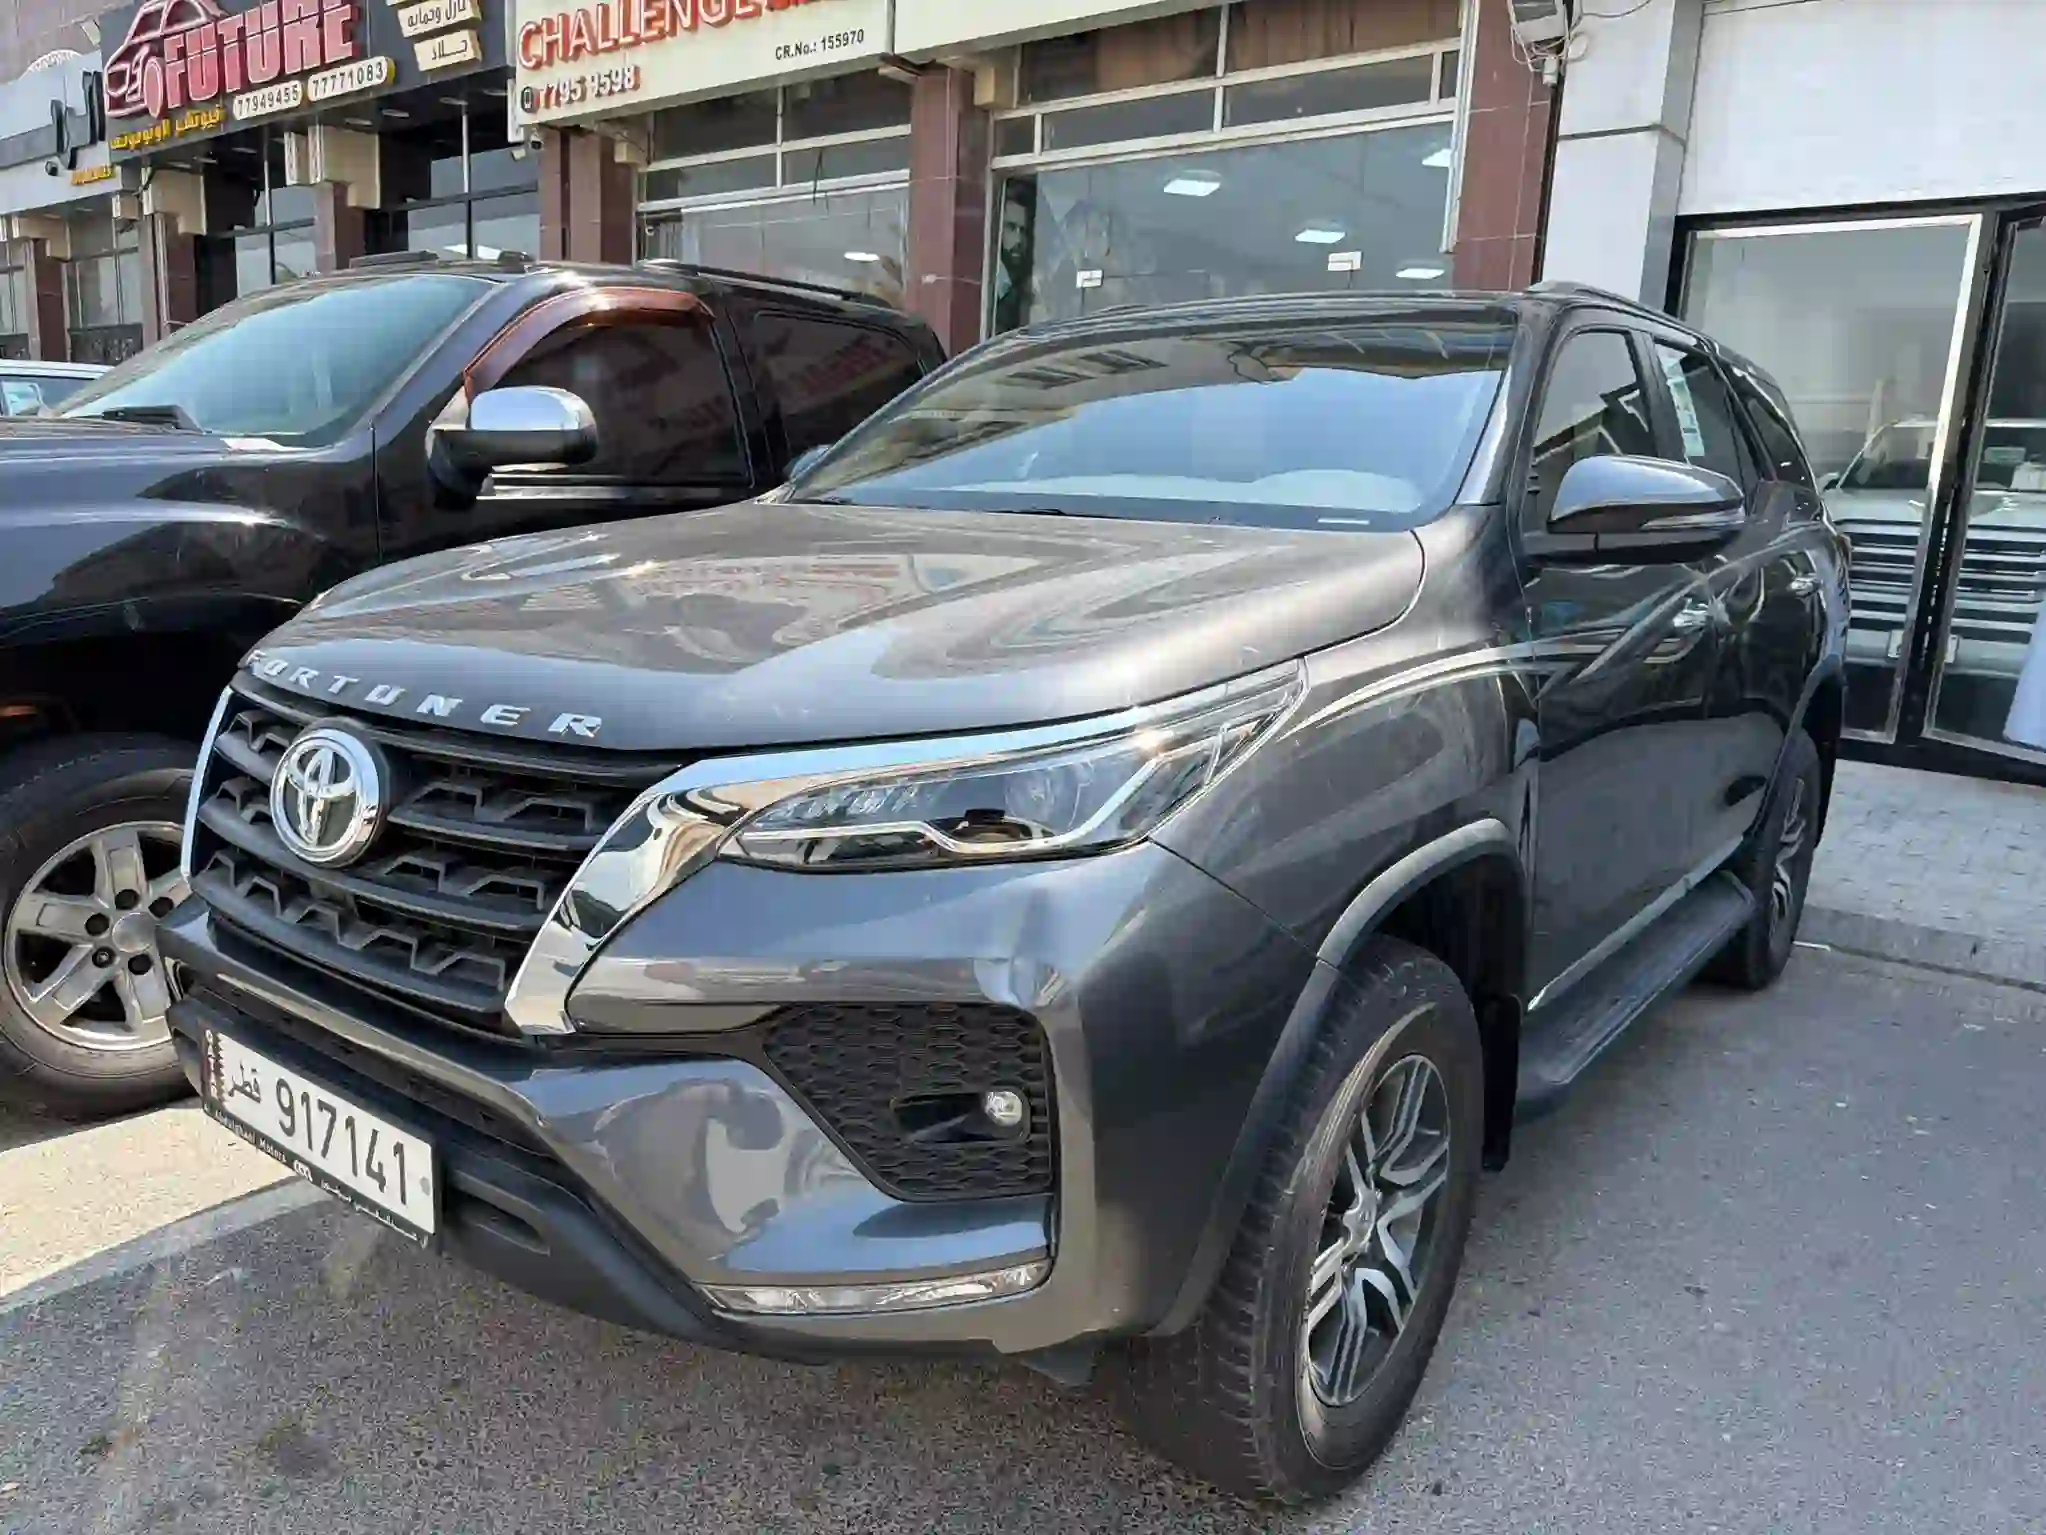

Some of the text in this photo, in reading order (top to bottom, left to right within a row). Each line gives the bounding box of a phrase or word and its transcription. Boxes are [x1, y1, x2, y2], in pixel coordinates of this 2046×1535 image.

[164, 0, 354, 109] FUTURE
[820, 28, 864, 51] 155970
[312, 62, 384, 98] 77771083
[246, 649, 603, 738] FORTUNER
[227, 1058, 262, 1104] قطر
[275, 1077, 407, 1206] 917141
